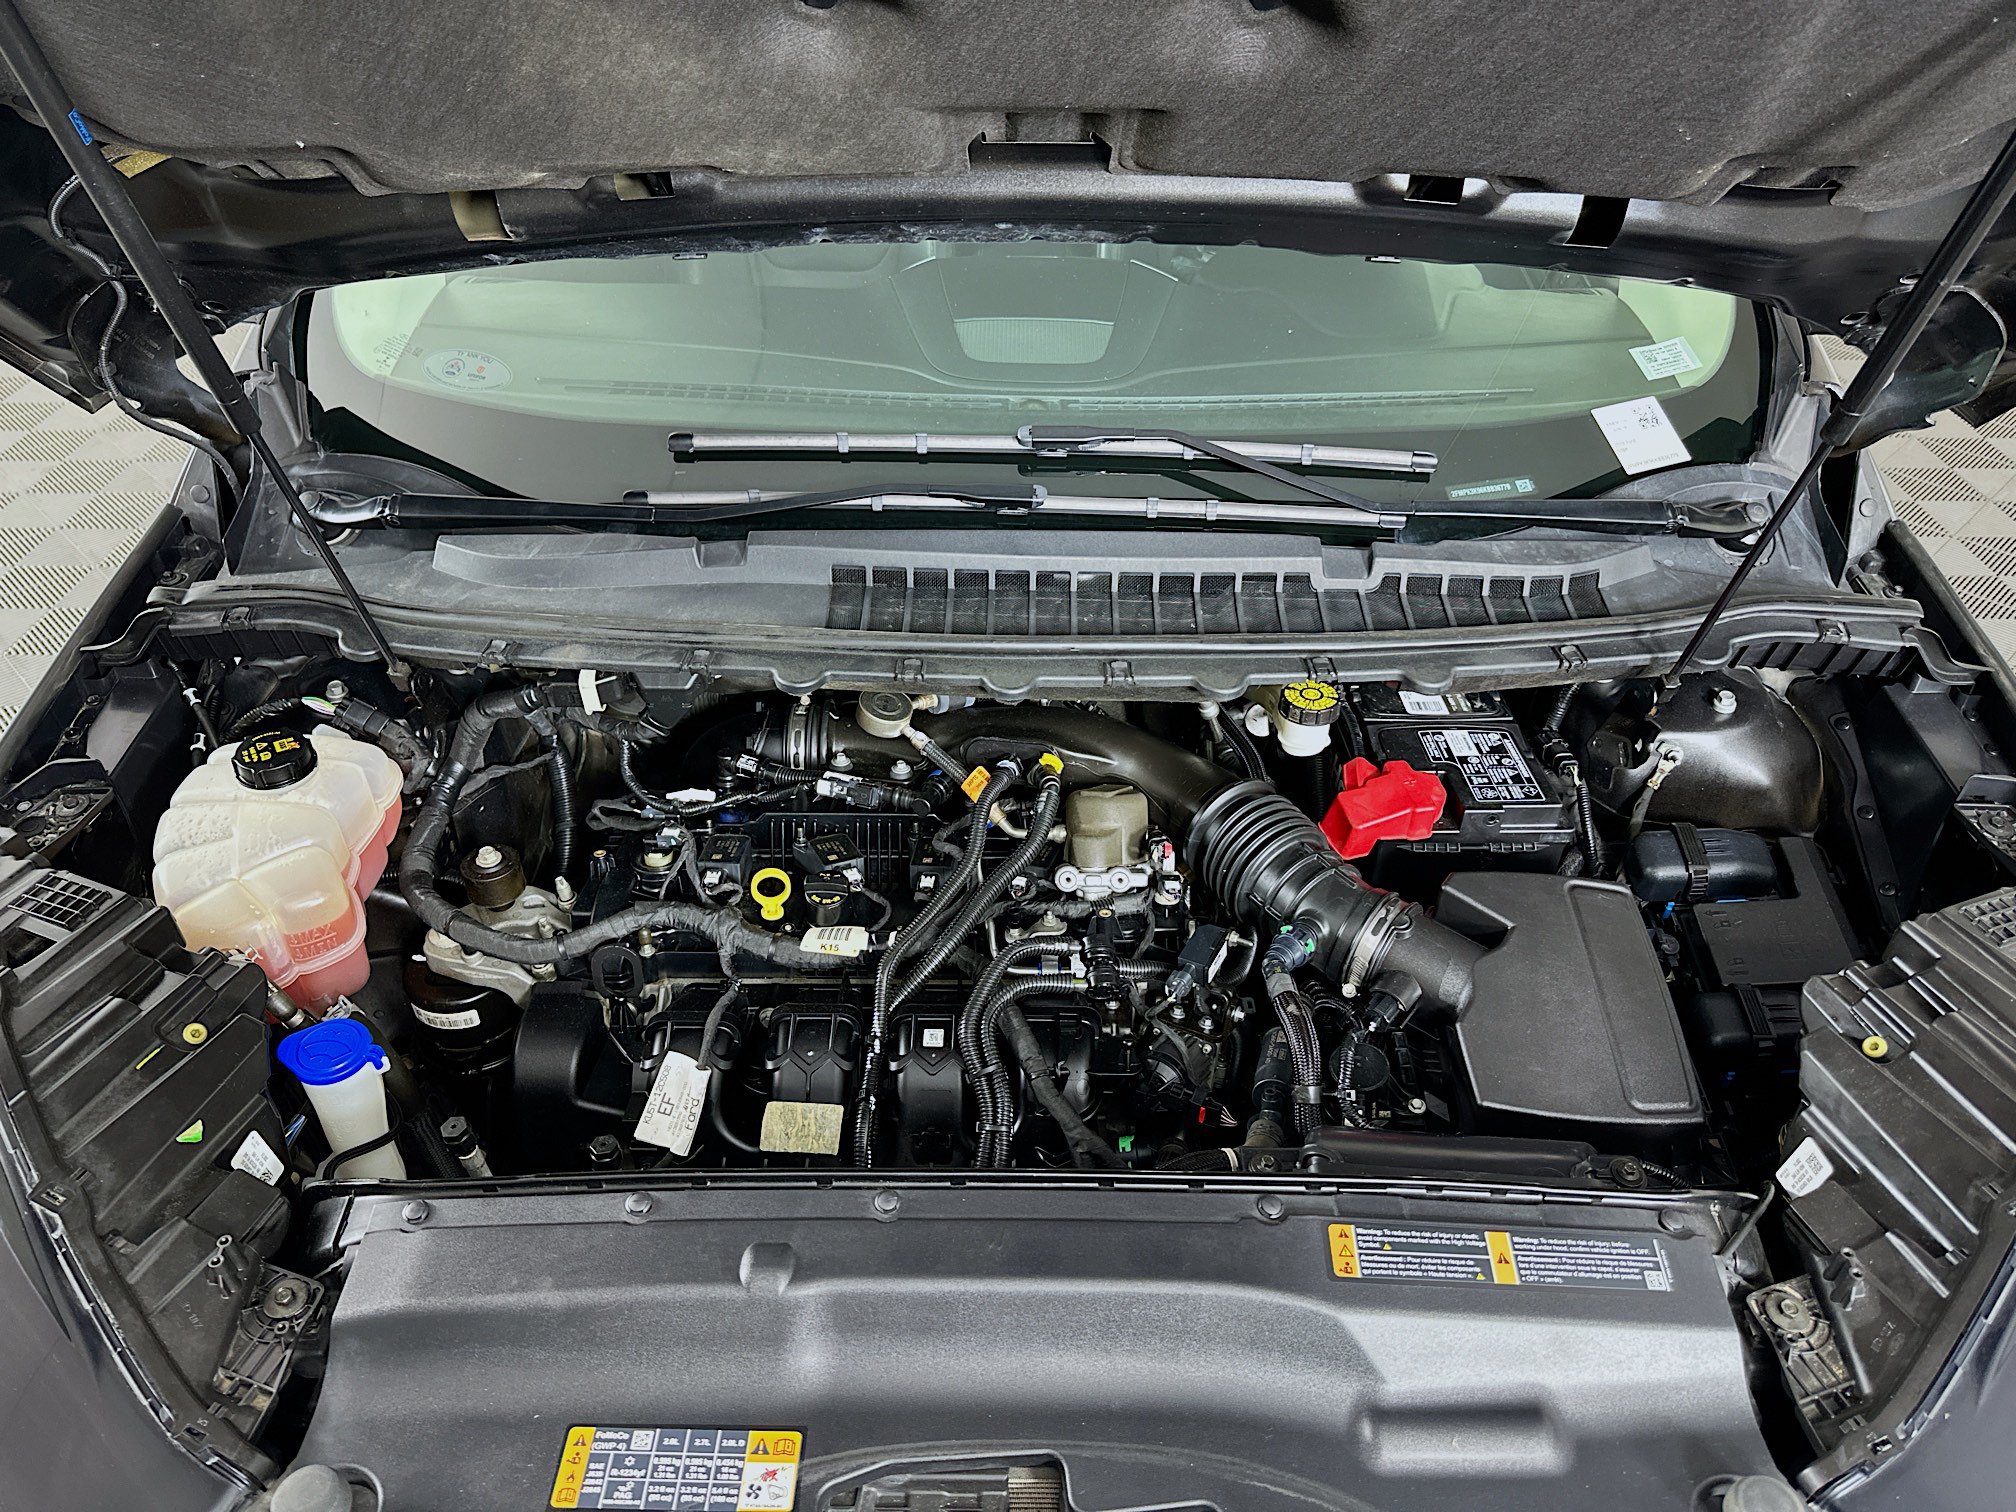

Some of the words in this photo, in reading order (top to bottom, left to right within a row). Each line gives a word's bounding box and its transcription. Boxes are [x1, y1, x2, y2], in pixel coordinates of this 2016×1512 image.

[819, 943, 840, 952] K15
[657, 1092, 675, 1117] EF
[594, 1430, 630, 1440] FoMoCo
[591, 1441, 617, 1451] (GWP
[616, 1442, 627, 1452] 4)
[610, 1468, 647, 1478] R-1234yf
[613, 1491, 633, 1500] PAG
